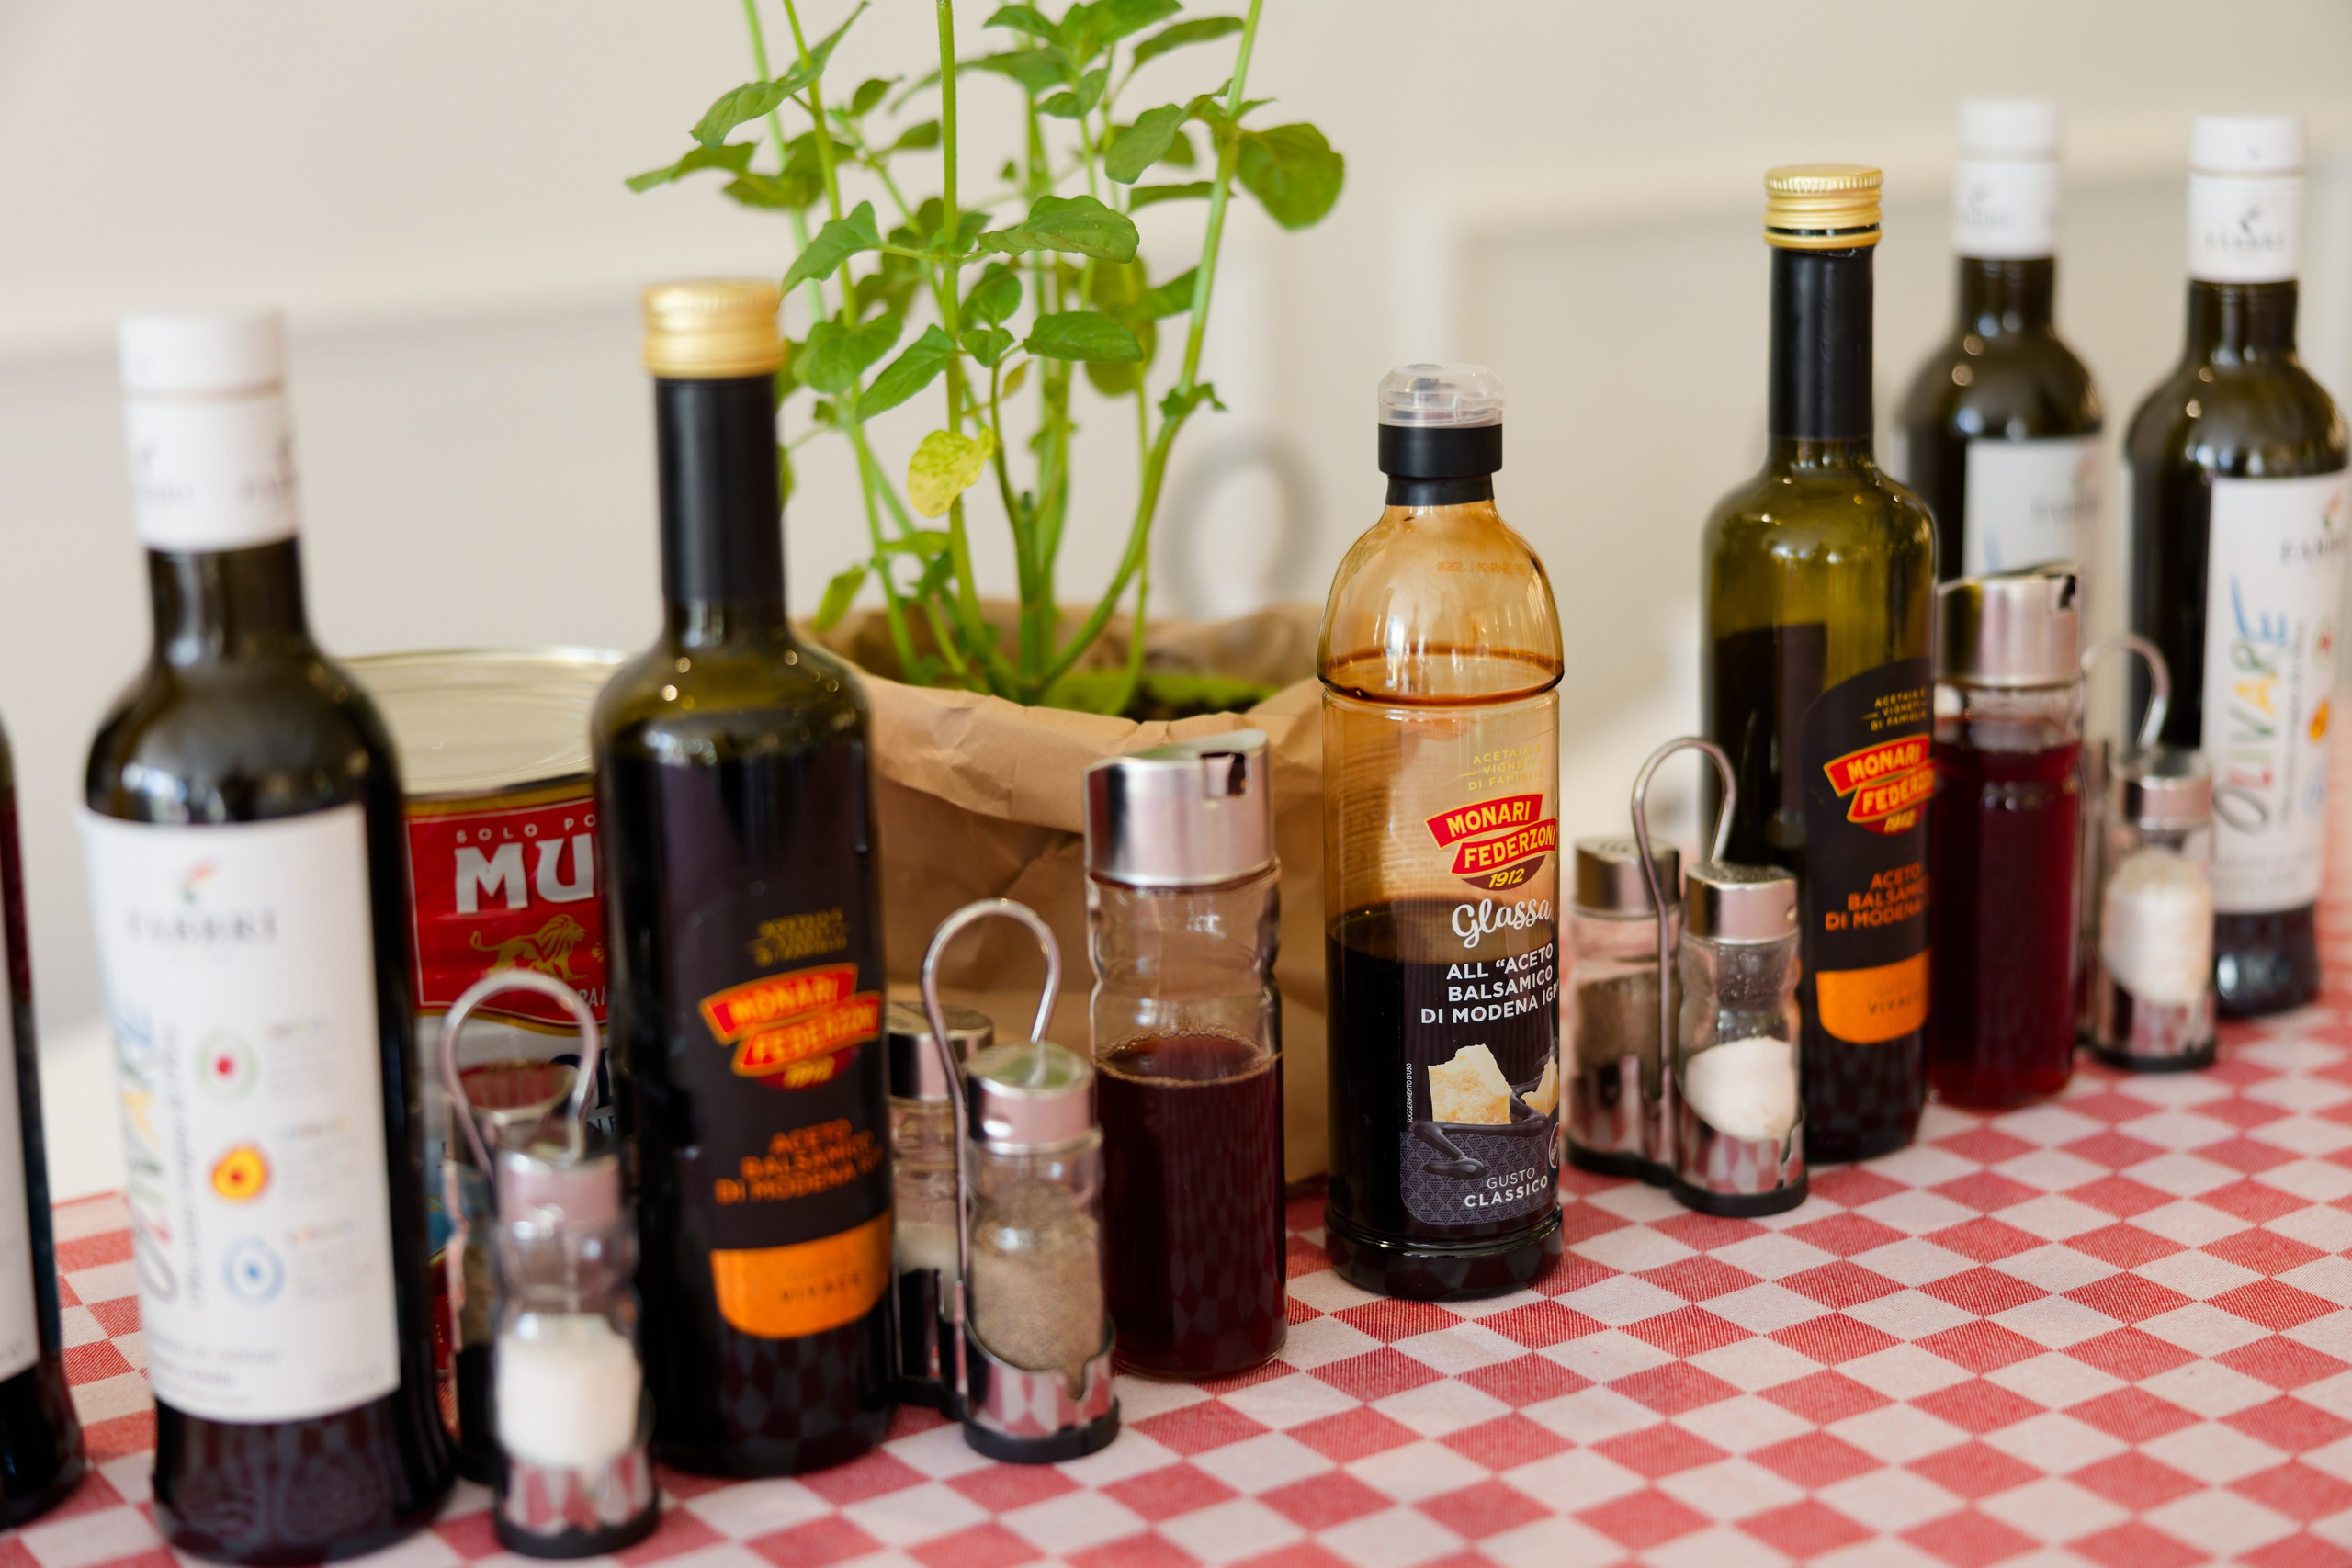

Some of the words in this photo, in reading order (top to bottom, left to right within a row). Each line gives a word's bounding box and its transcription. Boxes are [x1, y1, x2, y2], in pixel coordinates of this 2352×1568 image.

[2212, 573, 2287, 834] OLIVARE
[1473, 746, 1531, 764] ACETAIA
[1535, 744, 1542, 753] E
[1483, 758, 1535, 774] VIGNETI
[1847, 743, 1921, 784] MONARI
[1468, 780, 1482, 790] DI
[1489, 770, 1543, 786] FAMIGLIA
[455, 822, 538, 844] SOLO
[1446, 801, 1531, 838] MONARI
[1464, 825, 1556, 869] FEDERZONI
[1488, 868, 1525, 888] 1912
[1870, 862, 1922, 890] ACETO
[1452, 898, 1552, 949] Glassa
[1825, 911, 1848, 931] DI
[1853, 899, 1922, 928] MODENA
[1446, 962, 1488, 980] ALL
[1448, 965, 1553, 1002] BALSAMICO
[730, 976, 838, 1019] MONARI
[1421, 1008, 1443, 1024] DI
[1453, 996, 1539, 1024] MODENA
[1464, 1175, 1548, 1208] CLASSICO
[1487, 1167, 1535, 1189] GUSTO
